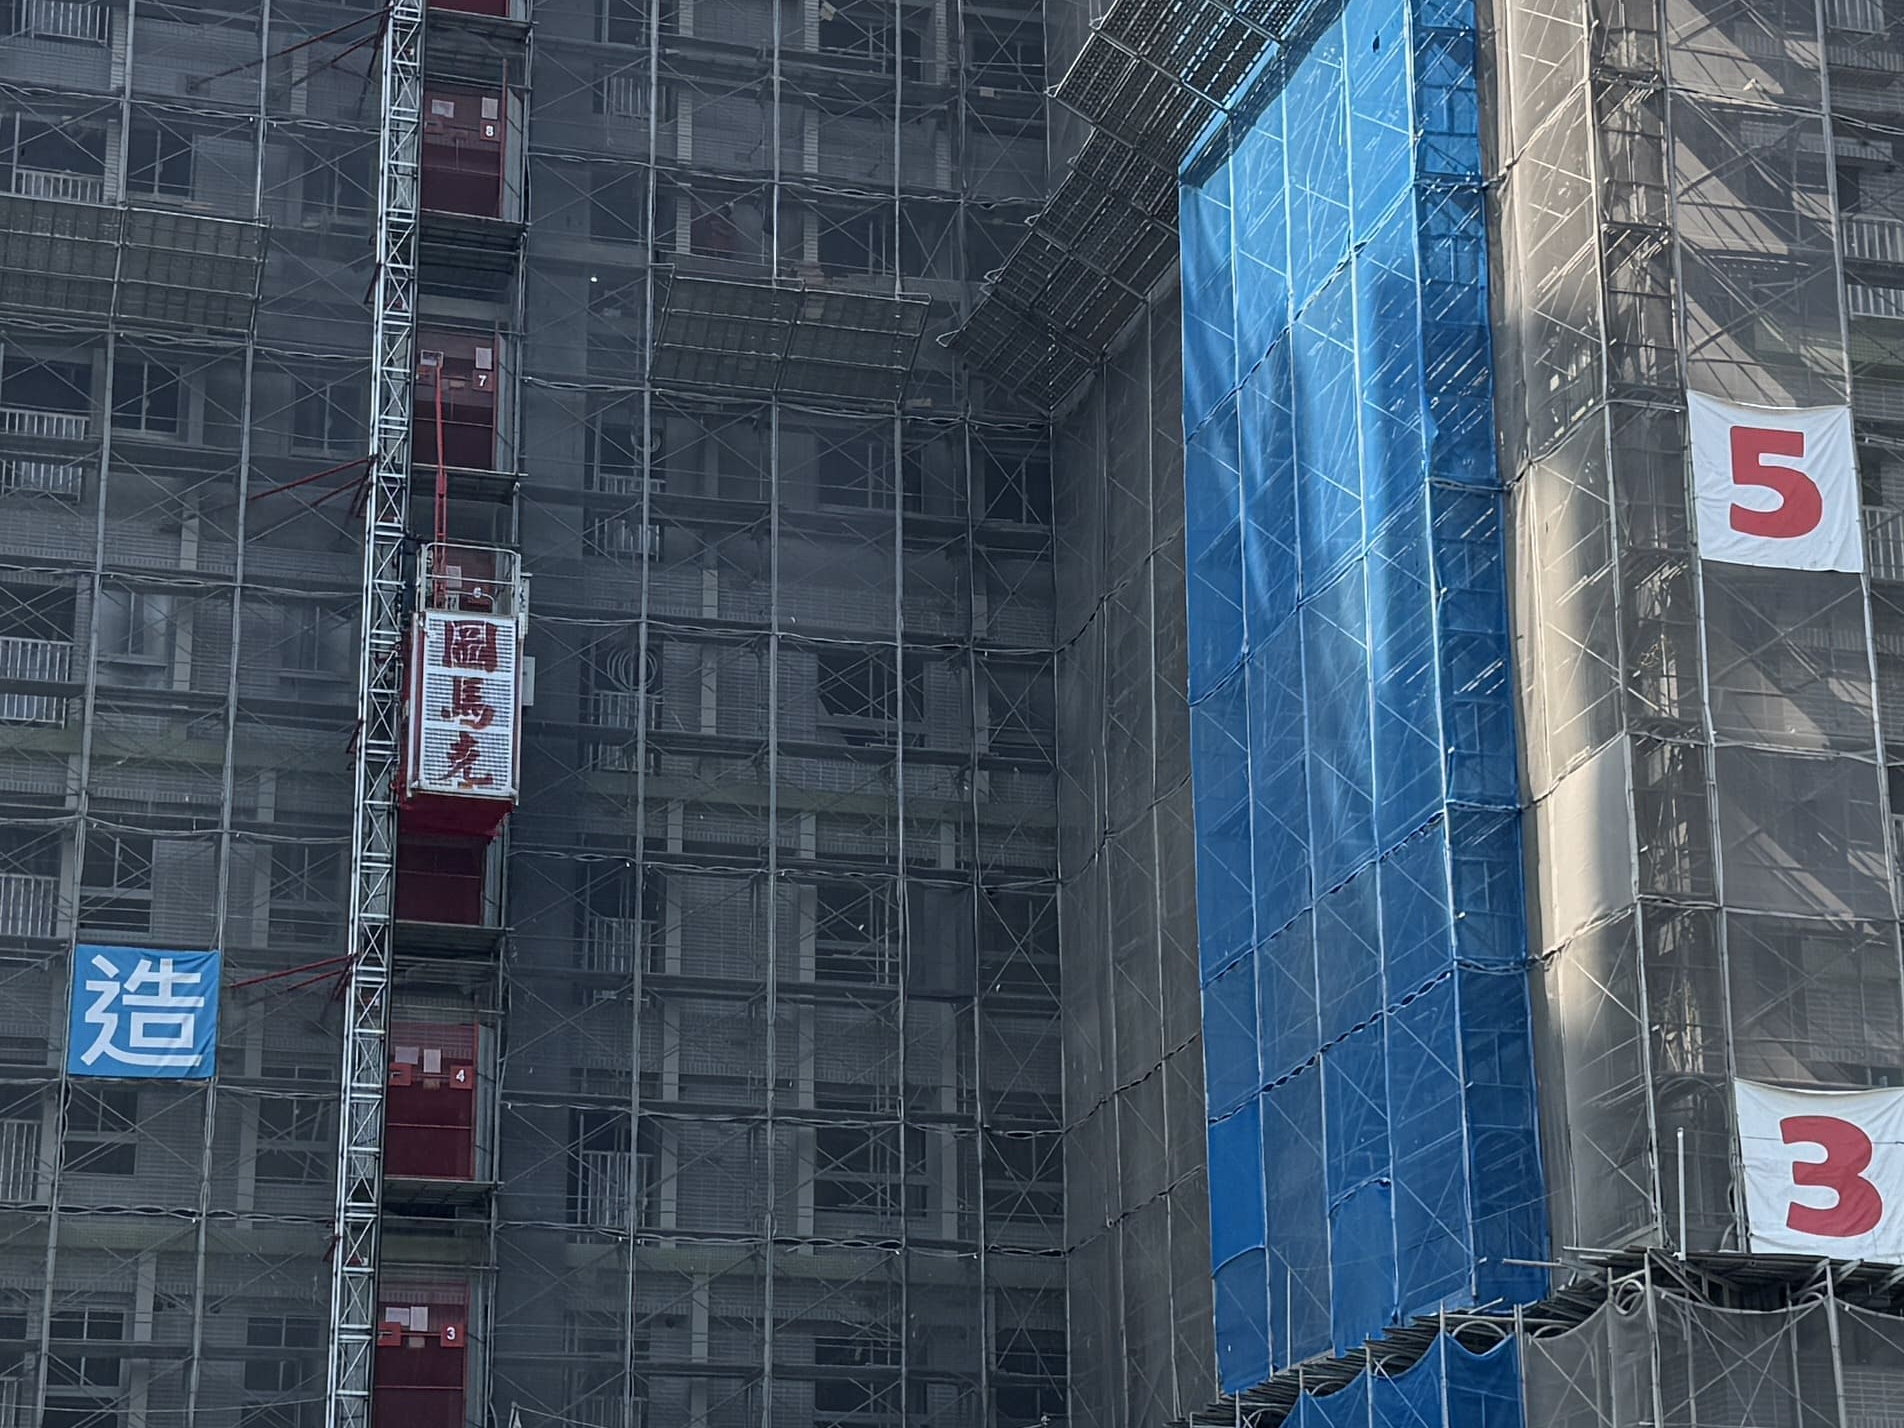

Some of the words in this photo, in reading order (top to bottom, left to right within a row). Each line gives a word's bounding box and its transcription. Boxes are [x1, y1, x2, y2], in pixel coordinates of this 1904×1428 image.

[485, 125, 494, 137] 8
[478, 374, 487, 387] 7
[1729, 425, 1823, 539] 5
[456, 1069, 465, 1083] 4
[1779, 1114, 1883, 1238] 3
[446, 1326, 456, 1340] 3
